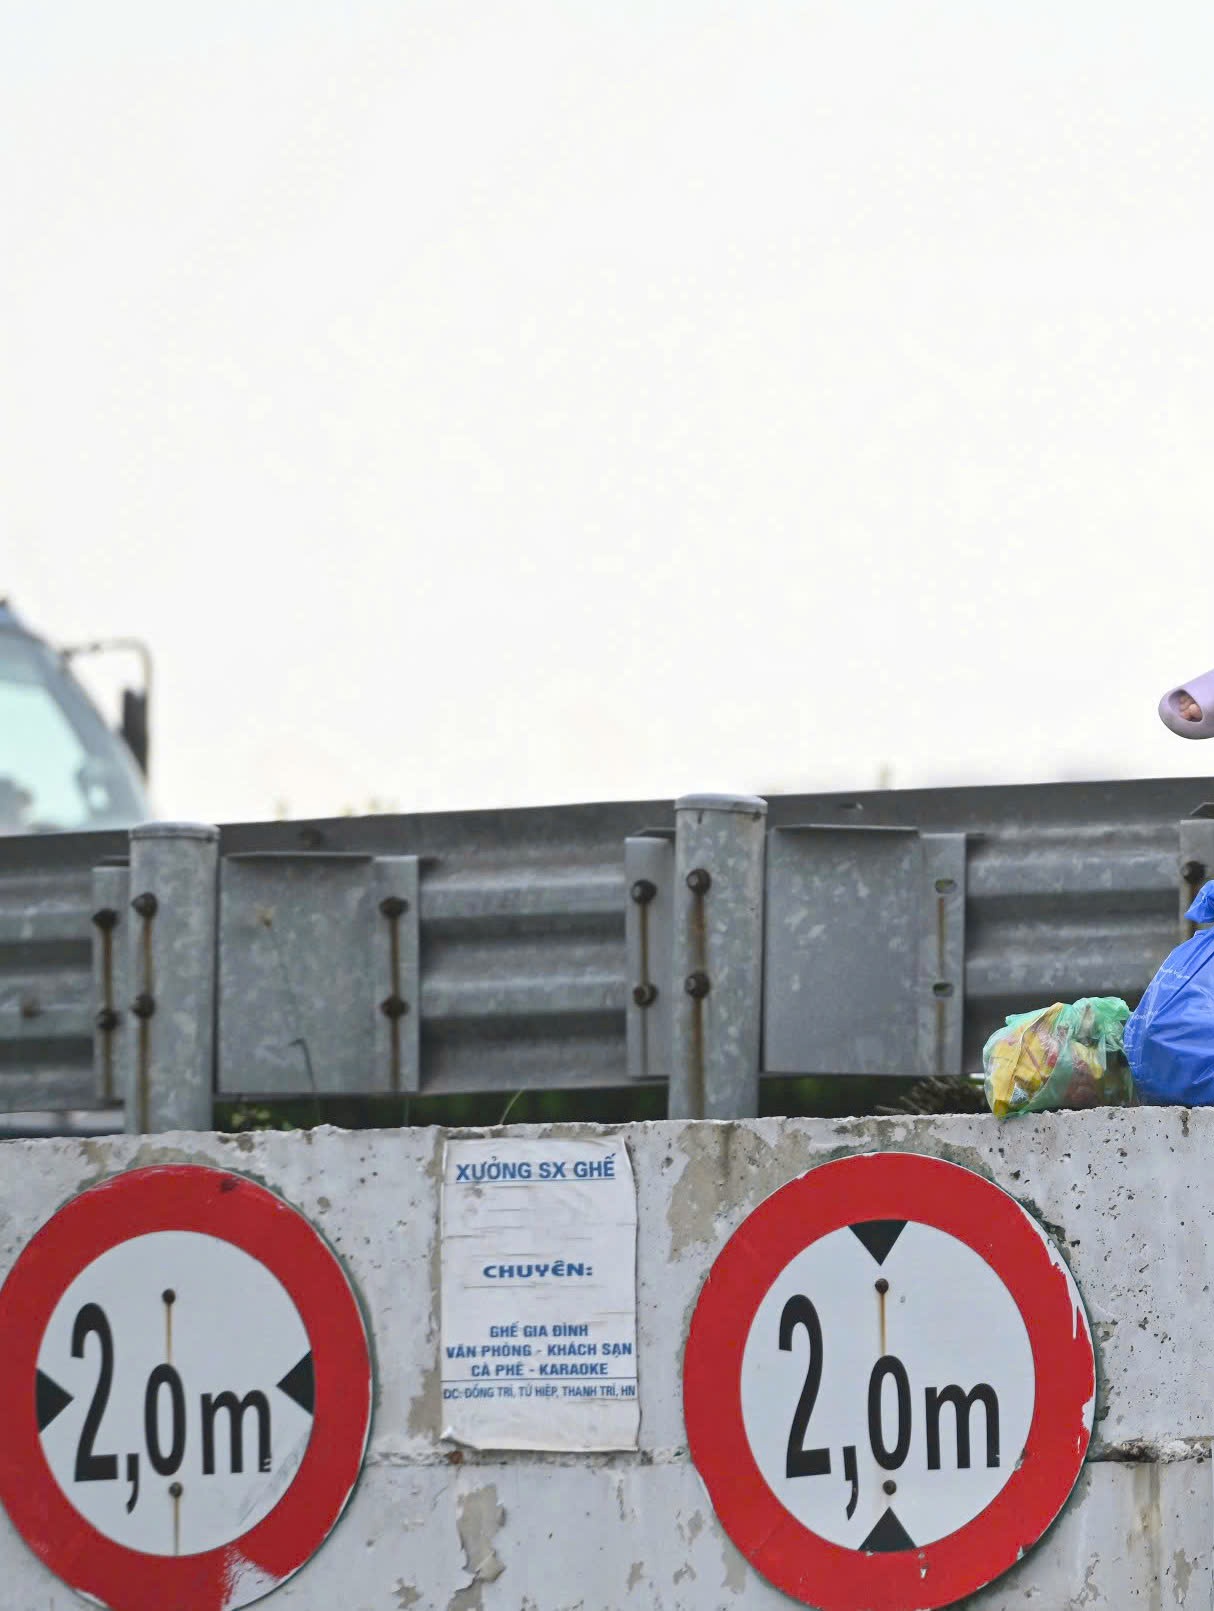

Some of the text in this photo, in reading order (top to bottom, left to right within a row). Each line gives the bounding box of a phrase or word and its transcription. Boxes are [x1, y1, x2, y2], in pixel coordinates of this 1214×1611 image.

[456, 1153, 617, 1181] XƯỞNG SX GHẾ
[483, 1260, 593, 1279] CHUYÊN:
[490, 1321, 588, 1338] GHẾ GIA ĐÌNH
[446, 1344, 477, 1359] VĂN
[481, 1342, 532, 1357] PHÒNG
[547, 1341, 598, 1356] KHÁCH
[602, 1342, 633, 1358] SẠN
[539, 1362, 609, 1376] KARAOKE
[562, 1385, 597, 1397] THANH
[621, 1384, 636, 1397] HN
[71, 1302, 272, 1515] 2,0m
[779, 1294, 1000, 1521] 2,0m
